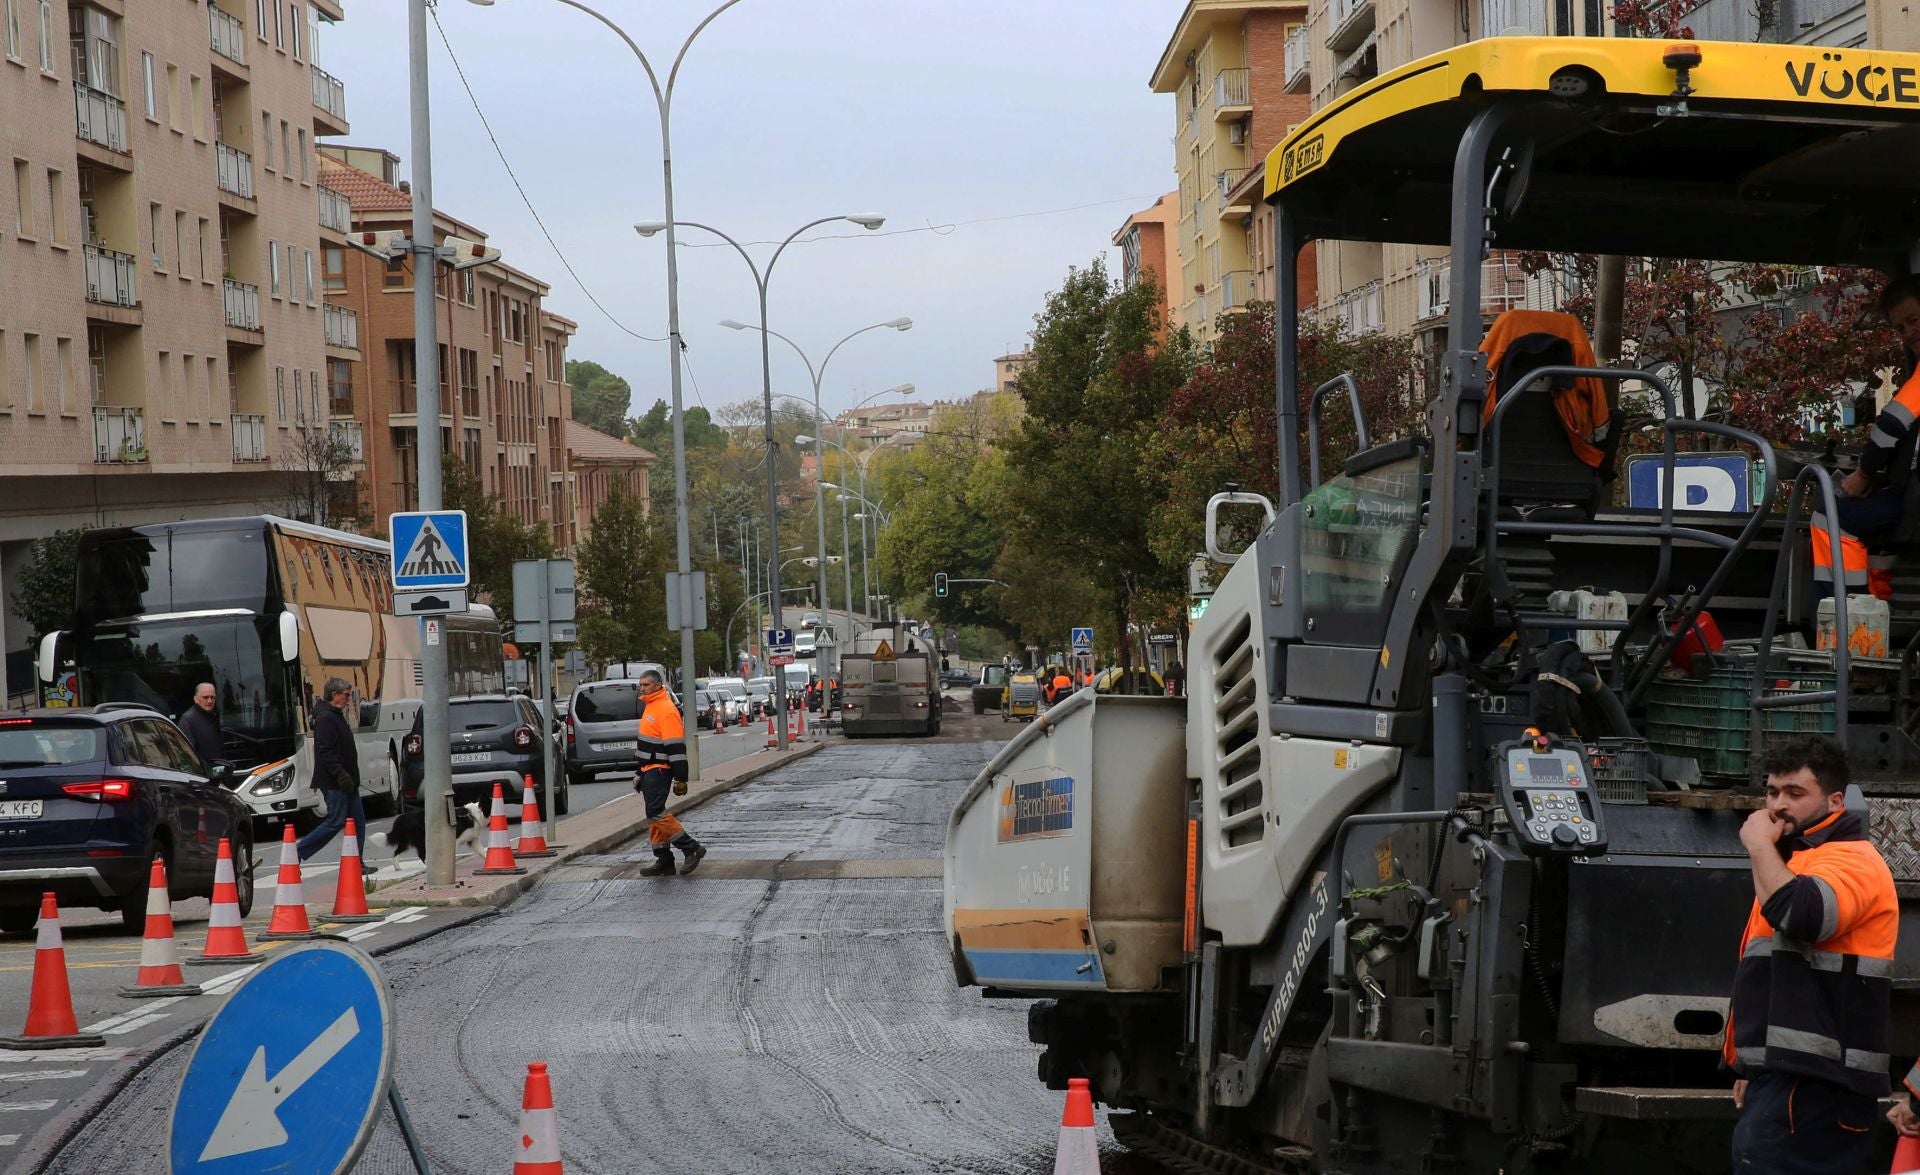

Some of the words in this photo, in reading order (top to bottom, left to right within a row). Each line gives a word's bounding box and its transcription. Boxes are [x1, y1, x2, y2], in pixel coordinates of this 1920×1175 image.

[1785, 52, 1920, 103] VÖGE
[776, 630, 786, 645] P
[13, 802, 39, 815] KFC
[1263, 970, 1295, 1053] SUPER
[1292, 881, 1329, 976] 1800-3i
